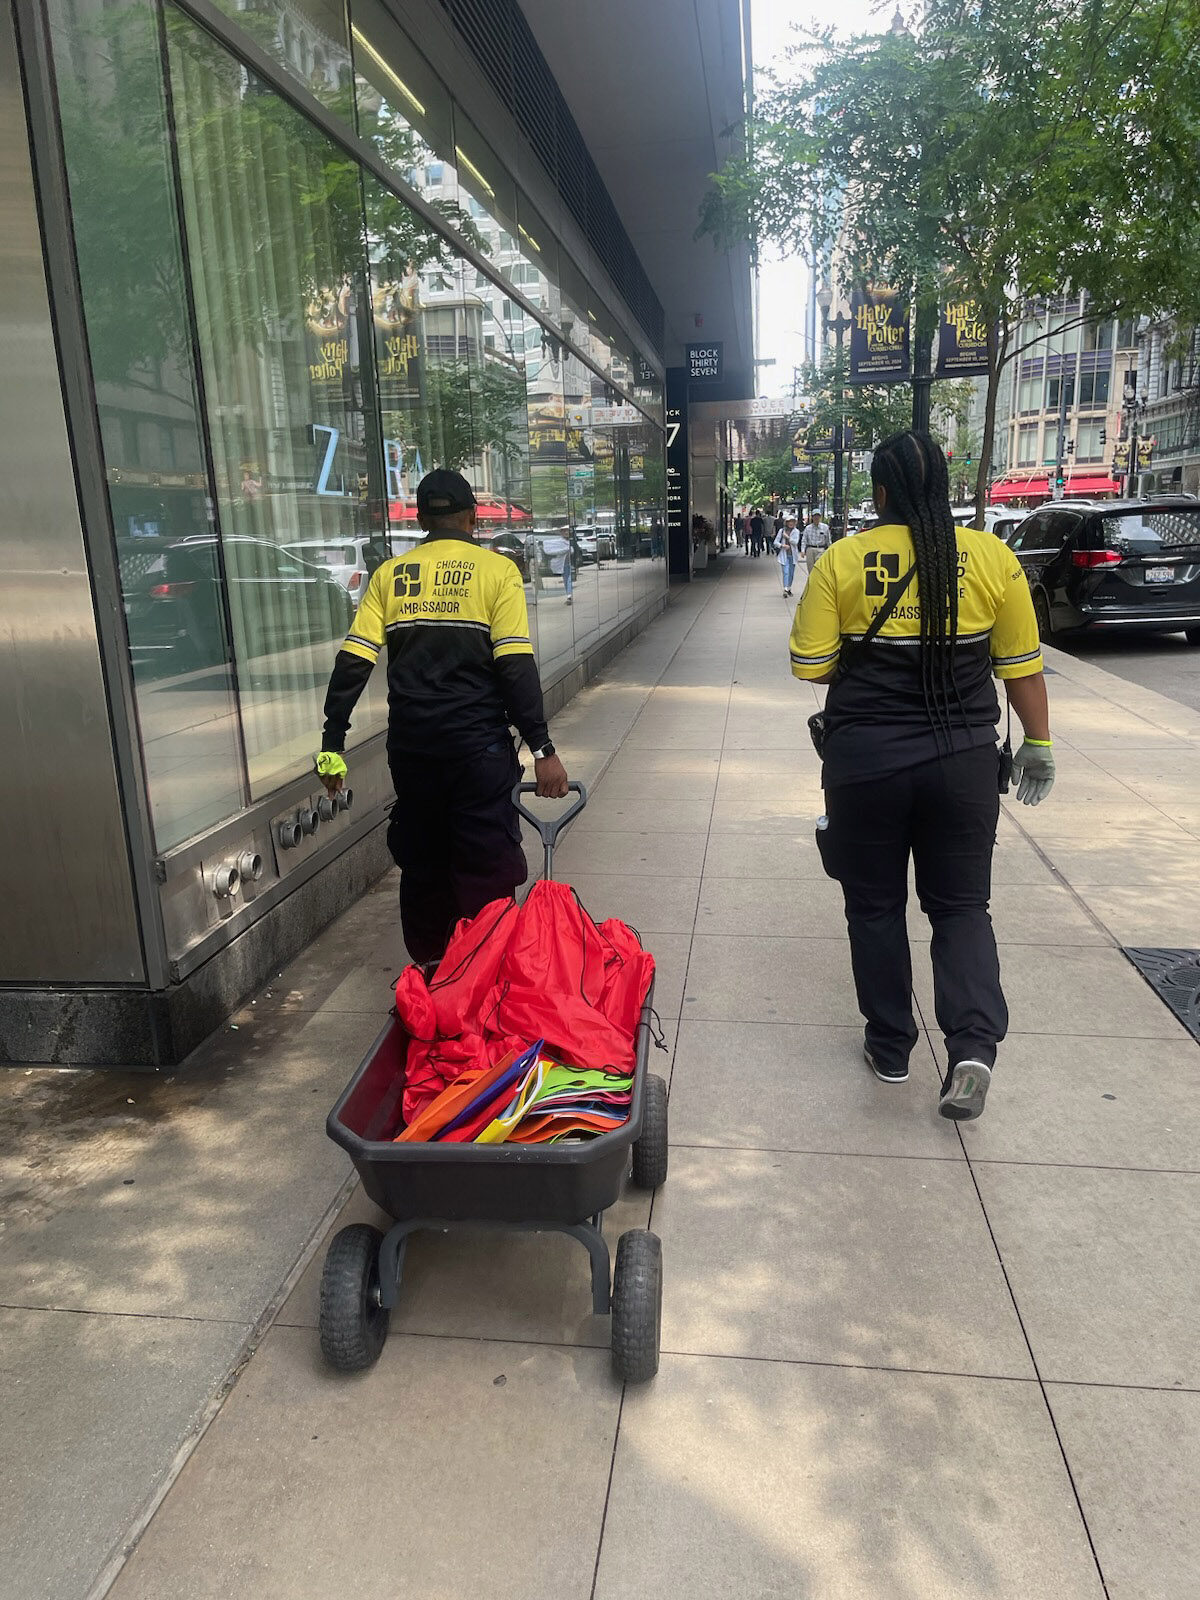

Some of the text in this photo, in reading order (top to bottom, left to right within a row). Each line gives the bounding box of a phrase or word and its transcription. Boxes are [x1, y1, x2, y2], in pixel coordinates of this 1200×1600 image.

[855, 303, 893, 330] Harry
[943, 299, 982, 326] Har
[867, 321, 905, 352] Potter
[690, 349, 719, 359] BLOCK
[690, 358, 719, 368] THIRTY
[691, 368, 718, 377] SEVEN
[436, 560, 475, 570] CHICAGO
[435, 571, 473, 586] LOOP
